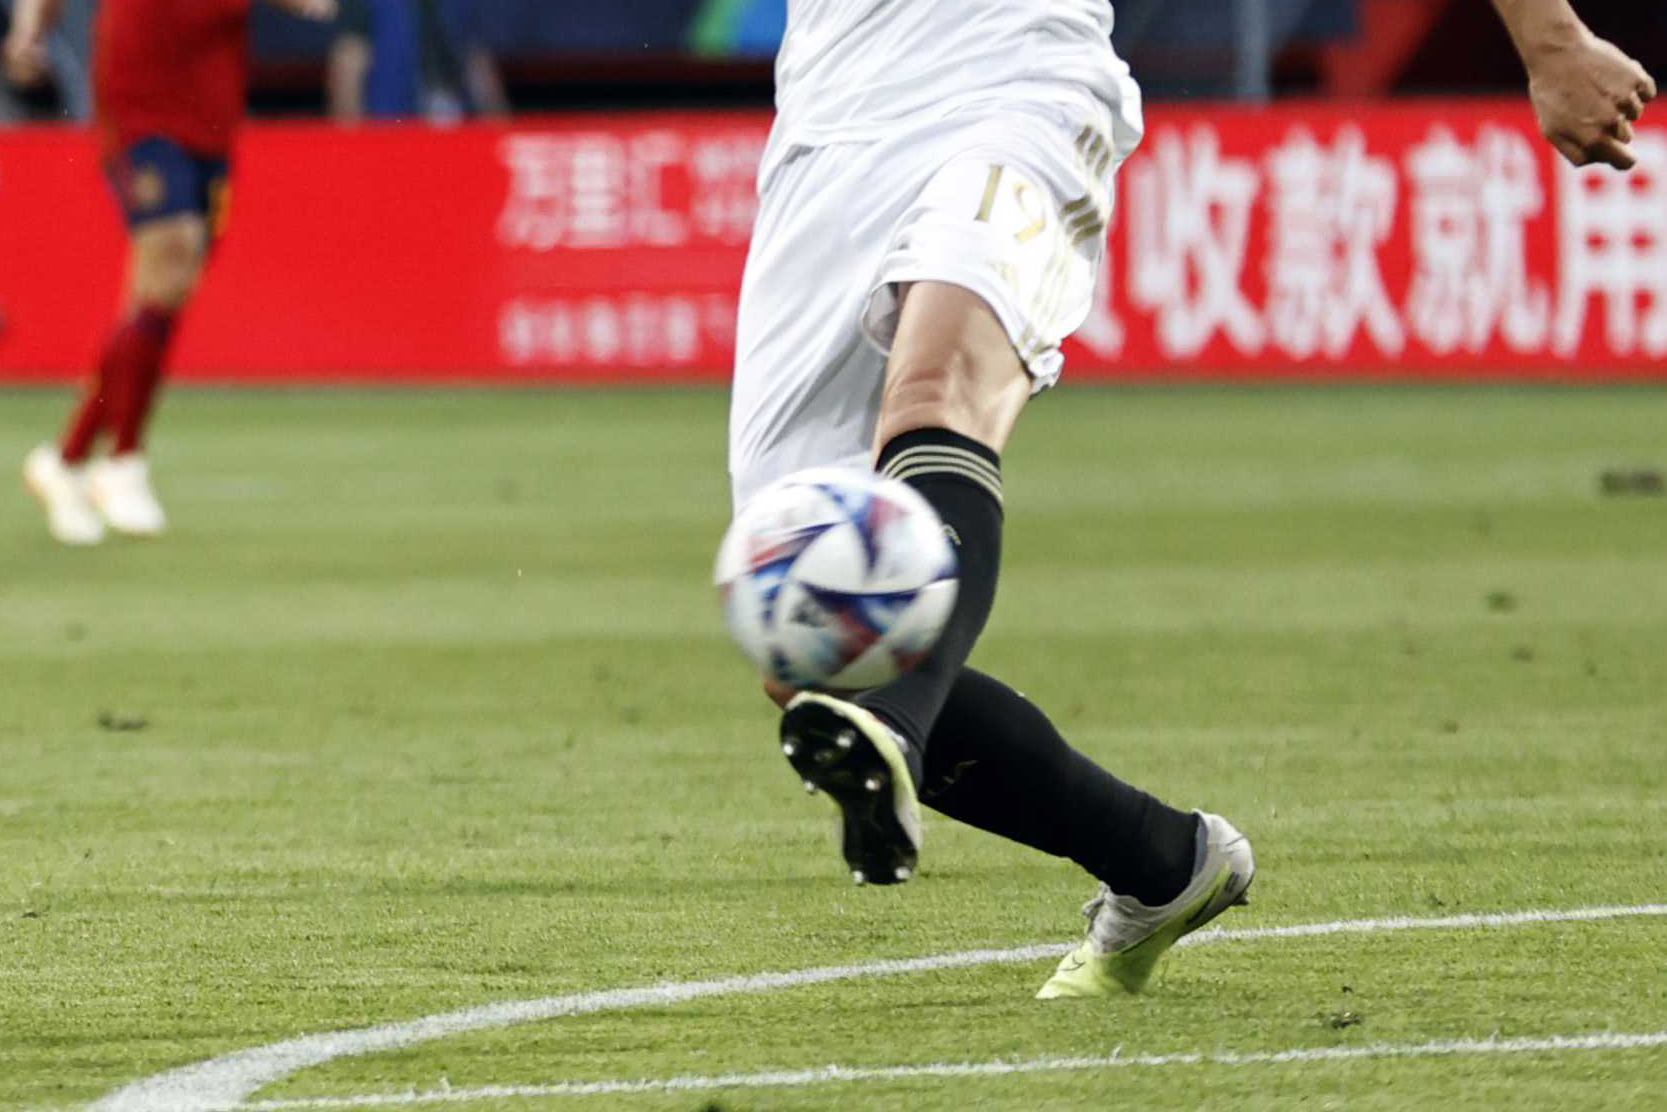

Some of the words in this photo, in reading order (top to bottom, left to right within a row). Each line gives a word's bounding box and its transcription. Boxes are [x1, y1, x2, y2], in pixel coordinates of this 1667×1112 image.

[973, 163, 1047, 245] 19
[1080, 124, 1667, 359] 收款就用
